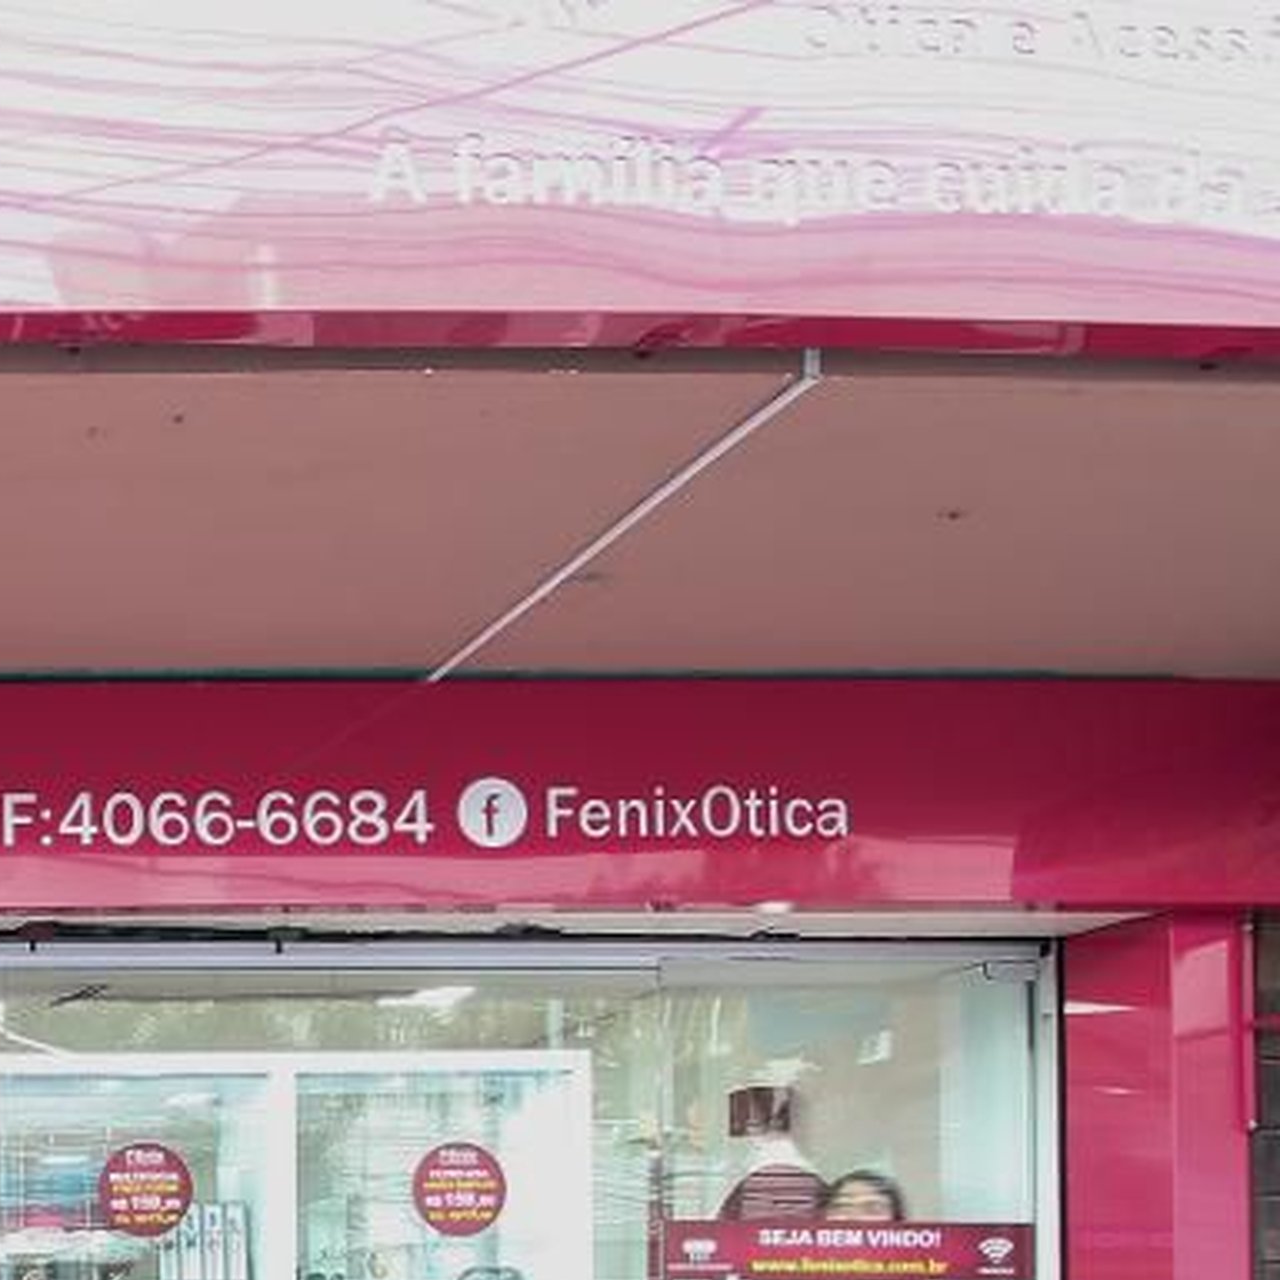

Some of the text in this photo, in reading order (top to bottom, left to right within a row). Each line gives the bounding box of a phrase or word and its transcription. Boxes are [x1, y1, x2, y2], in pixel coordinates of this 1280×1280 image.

[369, 137, 427, 203] A
[0, 790, 435, 848] F:4066-6684
[545, 784, 851, 840] FenixOtica
